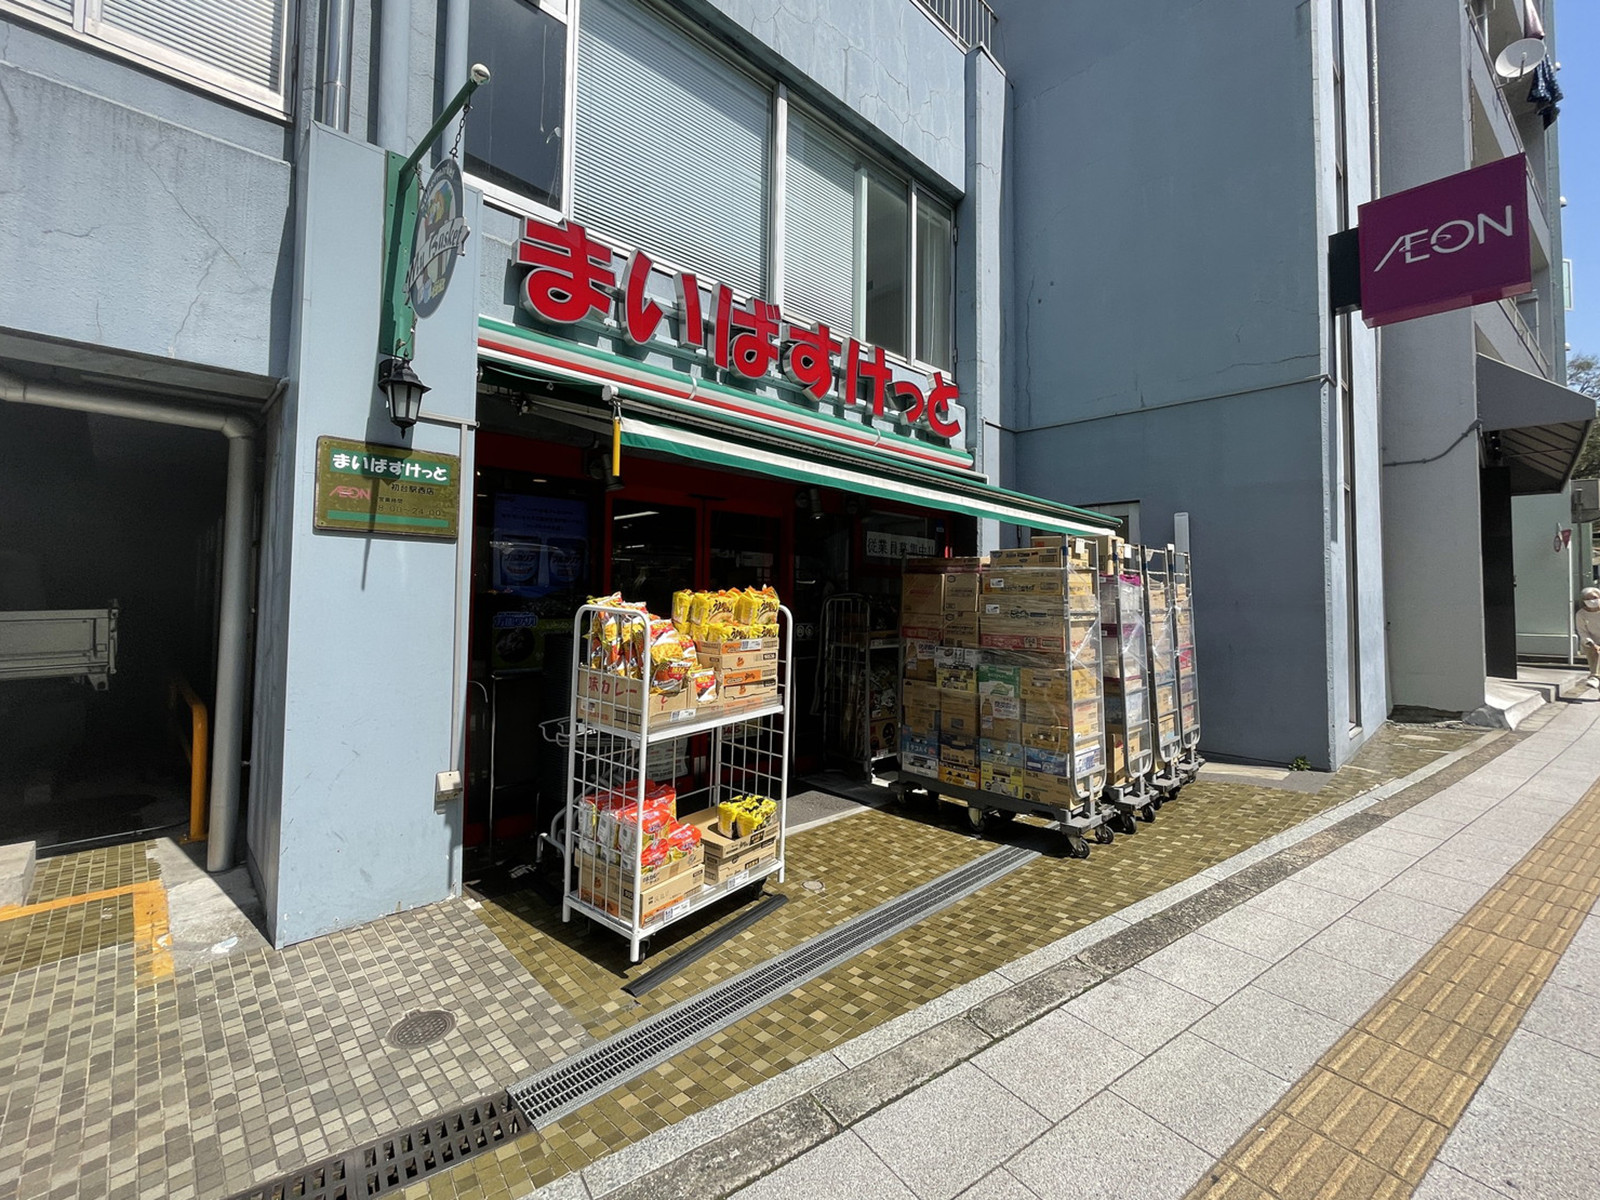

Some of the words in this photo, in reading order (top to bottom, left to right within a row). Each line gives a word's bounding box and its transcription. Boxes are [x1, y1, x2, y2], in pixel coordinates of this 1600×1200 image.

[429, 219, 463, 254] Basket
[514, 217, 962, 439] まいばすけっと
[332, 453, 447, 481] まいばすけっと
